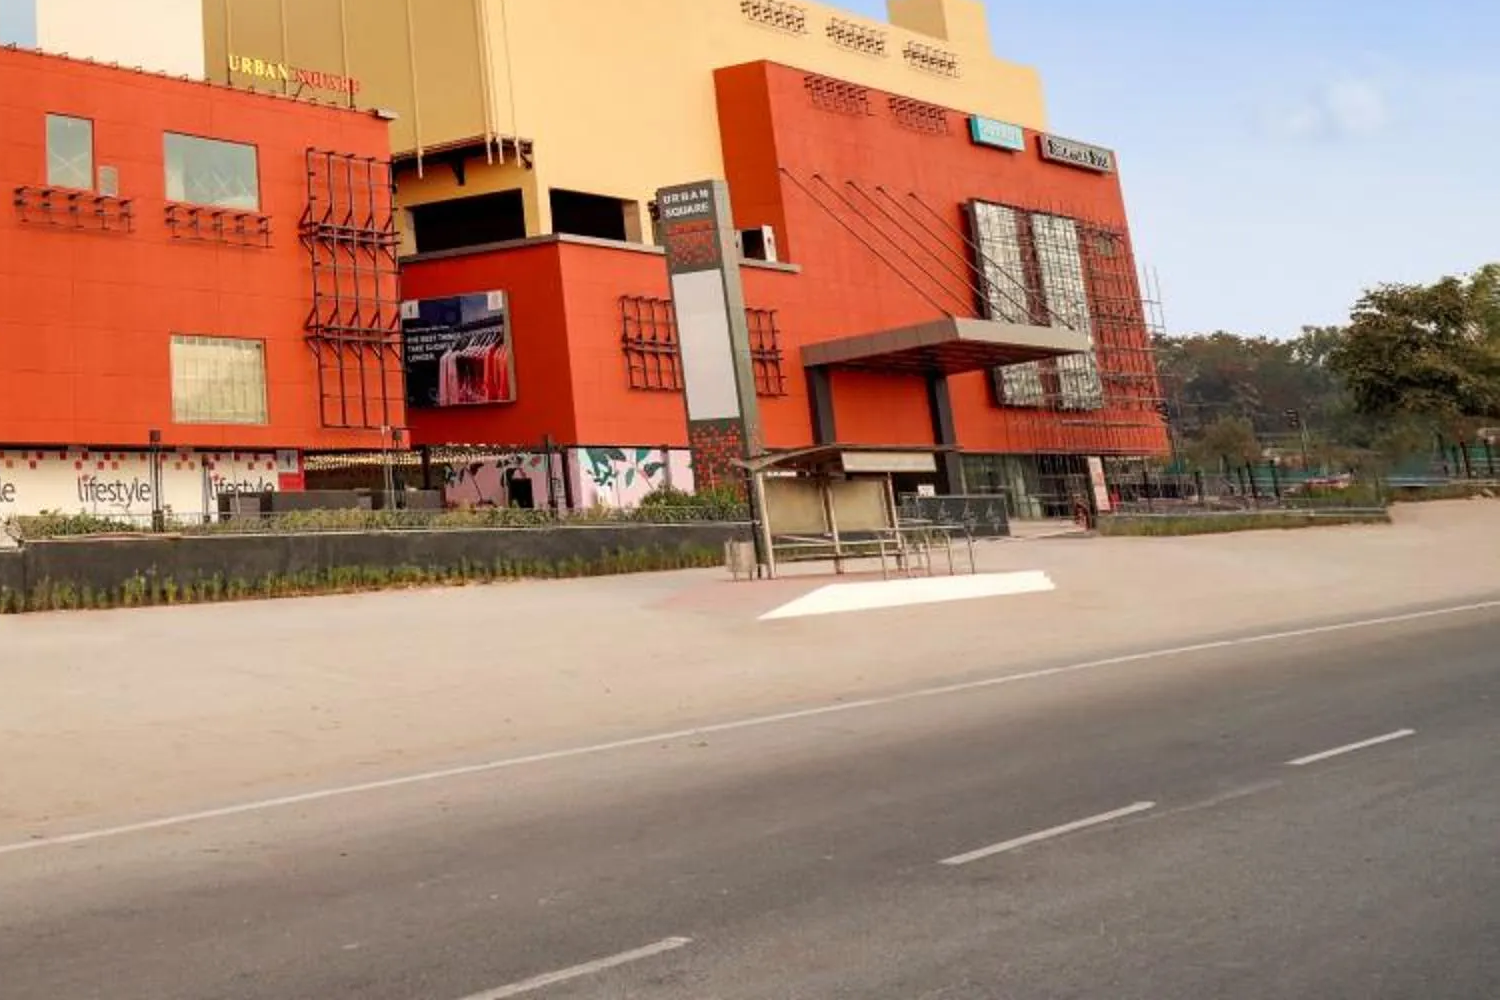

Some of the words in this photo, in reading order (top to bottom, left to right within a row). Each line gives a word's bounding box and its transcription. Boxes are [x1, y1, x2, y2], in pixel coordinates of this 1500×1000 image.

[228, 55, 288, 80] URBAN
[663, 188, 709, 204] URBAN
[665, 201, 708, 217] SQUARE
[77, 475, 151, 509] lifestyle
